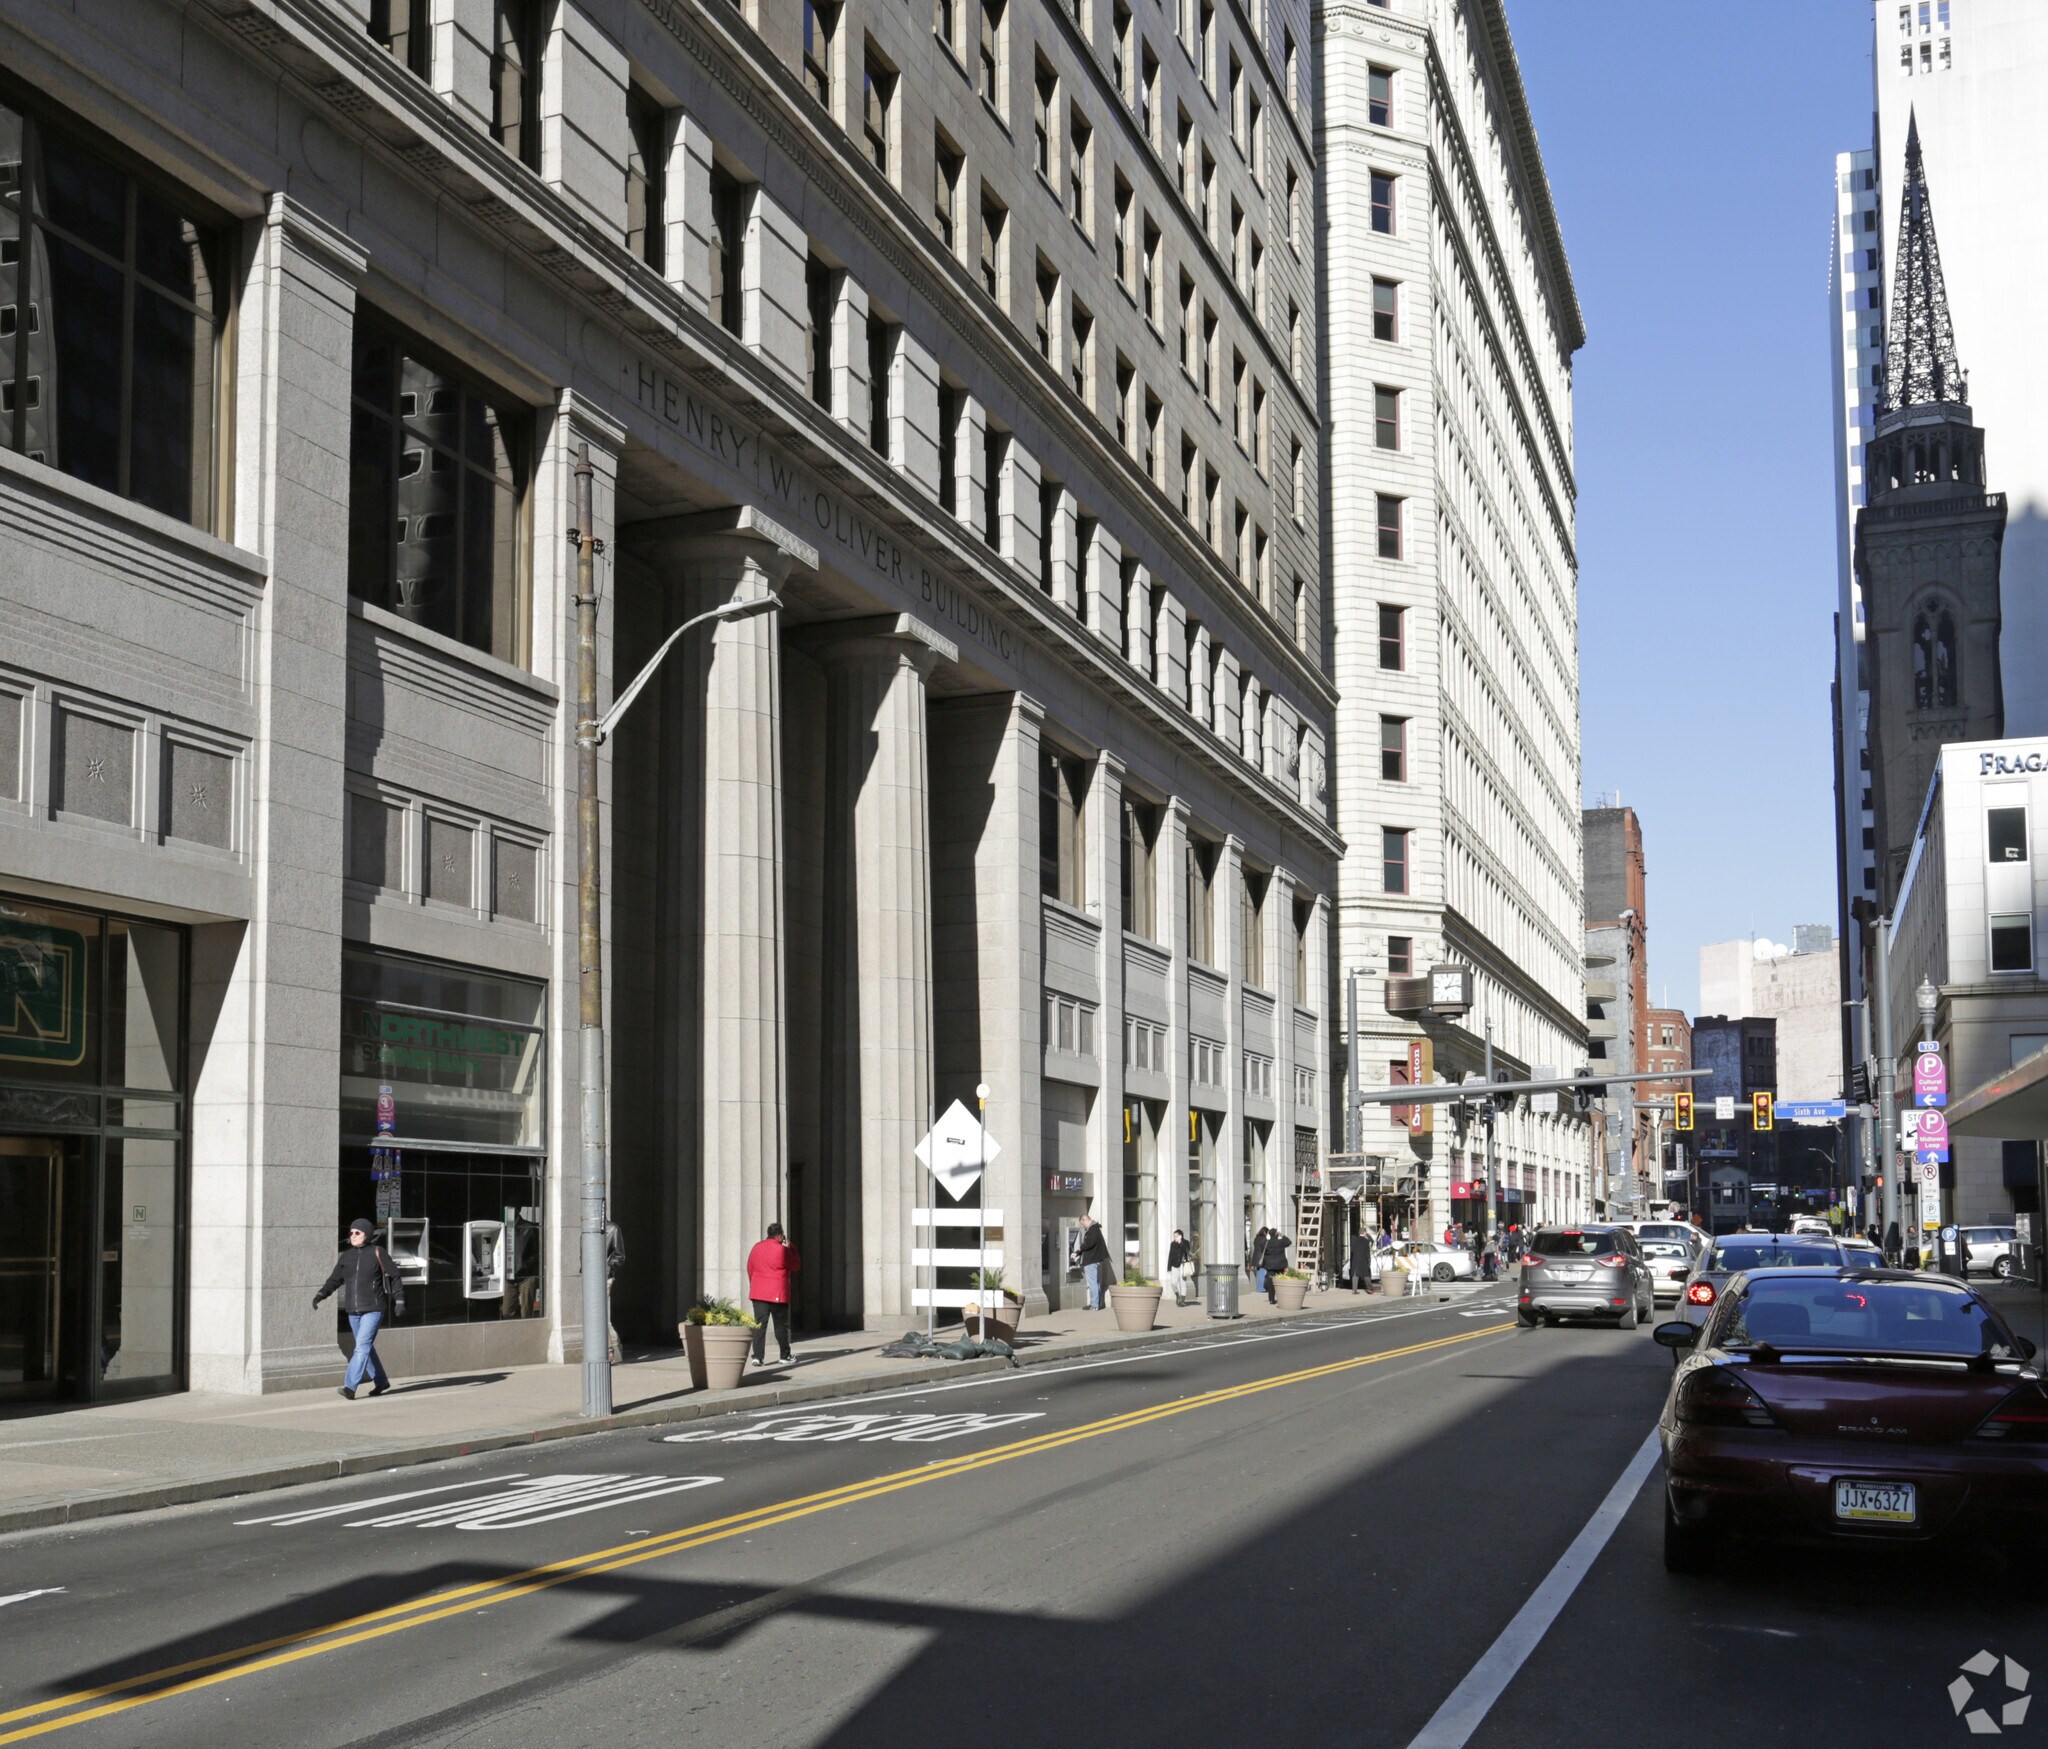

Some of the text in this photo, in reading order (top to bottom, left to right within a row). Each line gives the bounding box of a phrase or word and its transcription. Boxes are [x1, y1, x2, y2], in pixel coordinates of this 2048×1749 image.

[637, 361, 1011, 660] HENRY W OLIVER BUILDING
[1979, 752, 2048, 776] FRAG
[362, 1009, 525, 1057] NORTHWEST
[1412, 1049, 1422, 1127] Bungton
[1794, 1107, 1826, 1116] Sixth Ave
[1838, 1425, 1884, 1433] GRAND
[1856, 1483, 1895, 1491] PENNSYLVANIA
